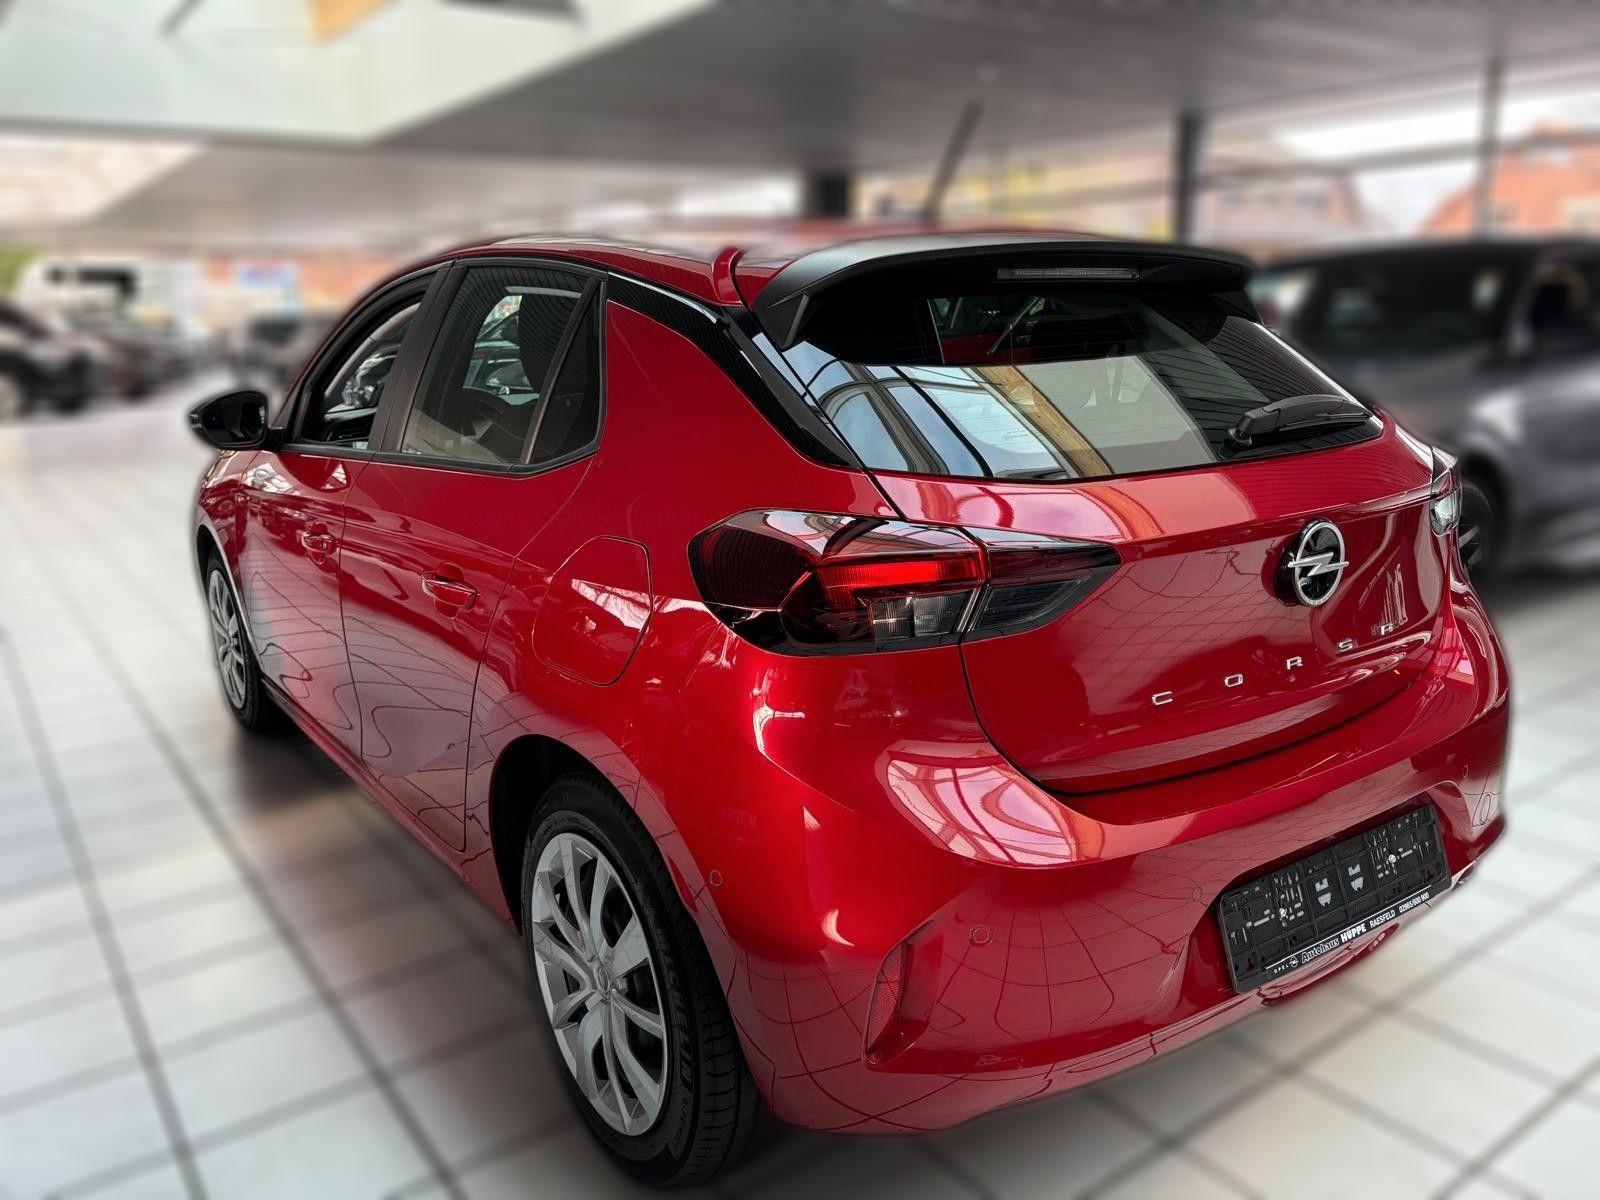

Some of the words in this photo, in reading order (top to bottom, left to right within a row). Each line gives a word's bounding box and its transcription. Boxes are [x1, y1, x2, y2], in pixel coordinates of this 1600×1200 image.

[1274, 964, 1289, 974] OPEL
[1301, 938, 1339, 963] Autohaus
[1340, 923, 1367, 943] HÜPPE
[1369, 909, 1396, 929] RAESFELD
